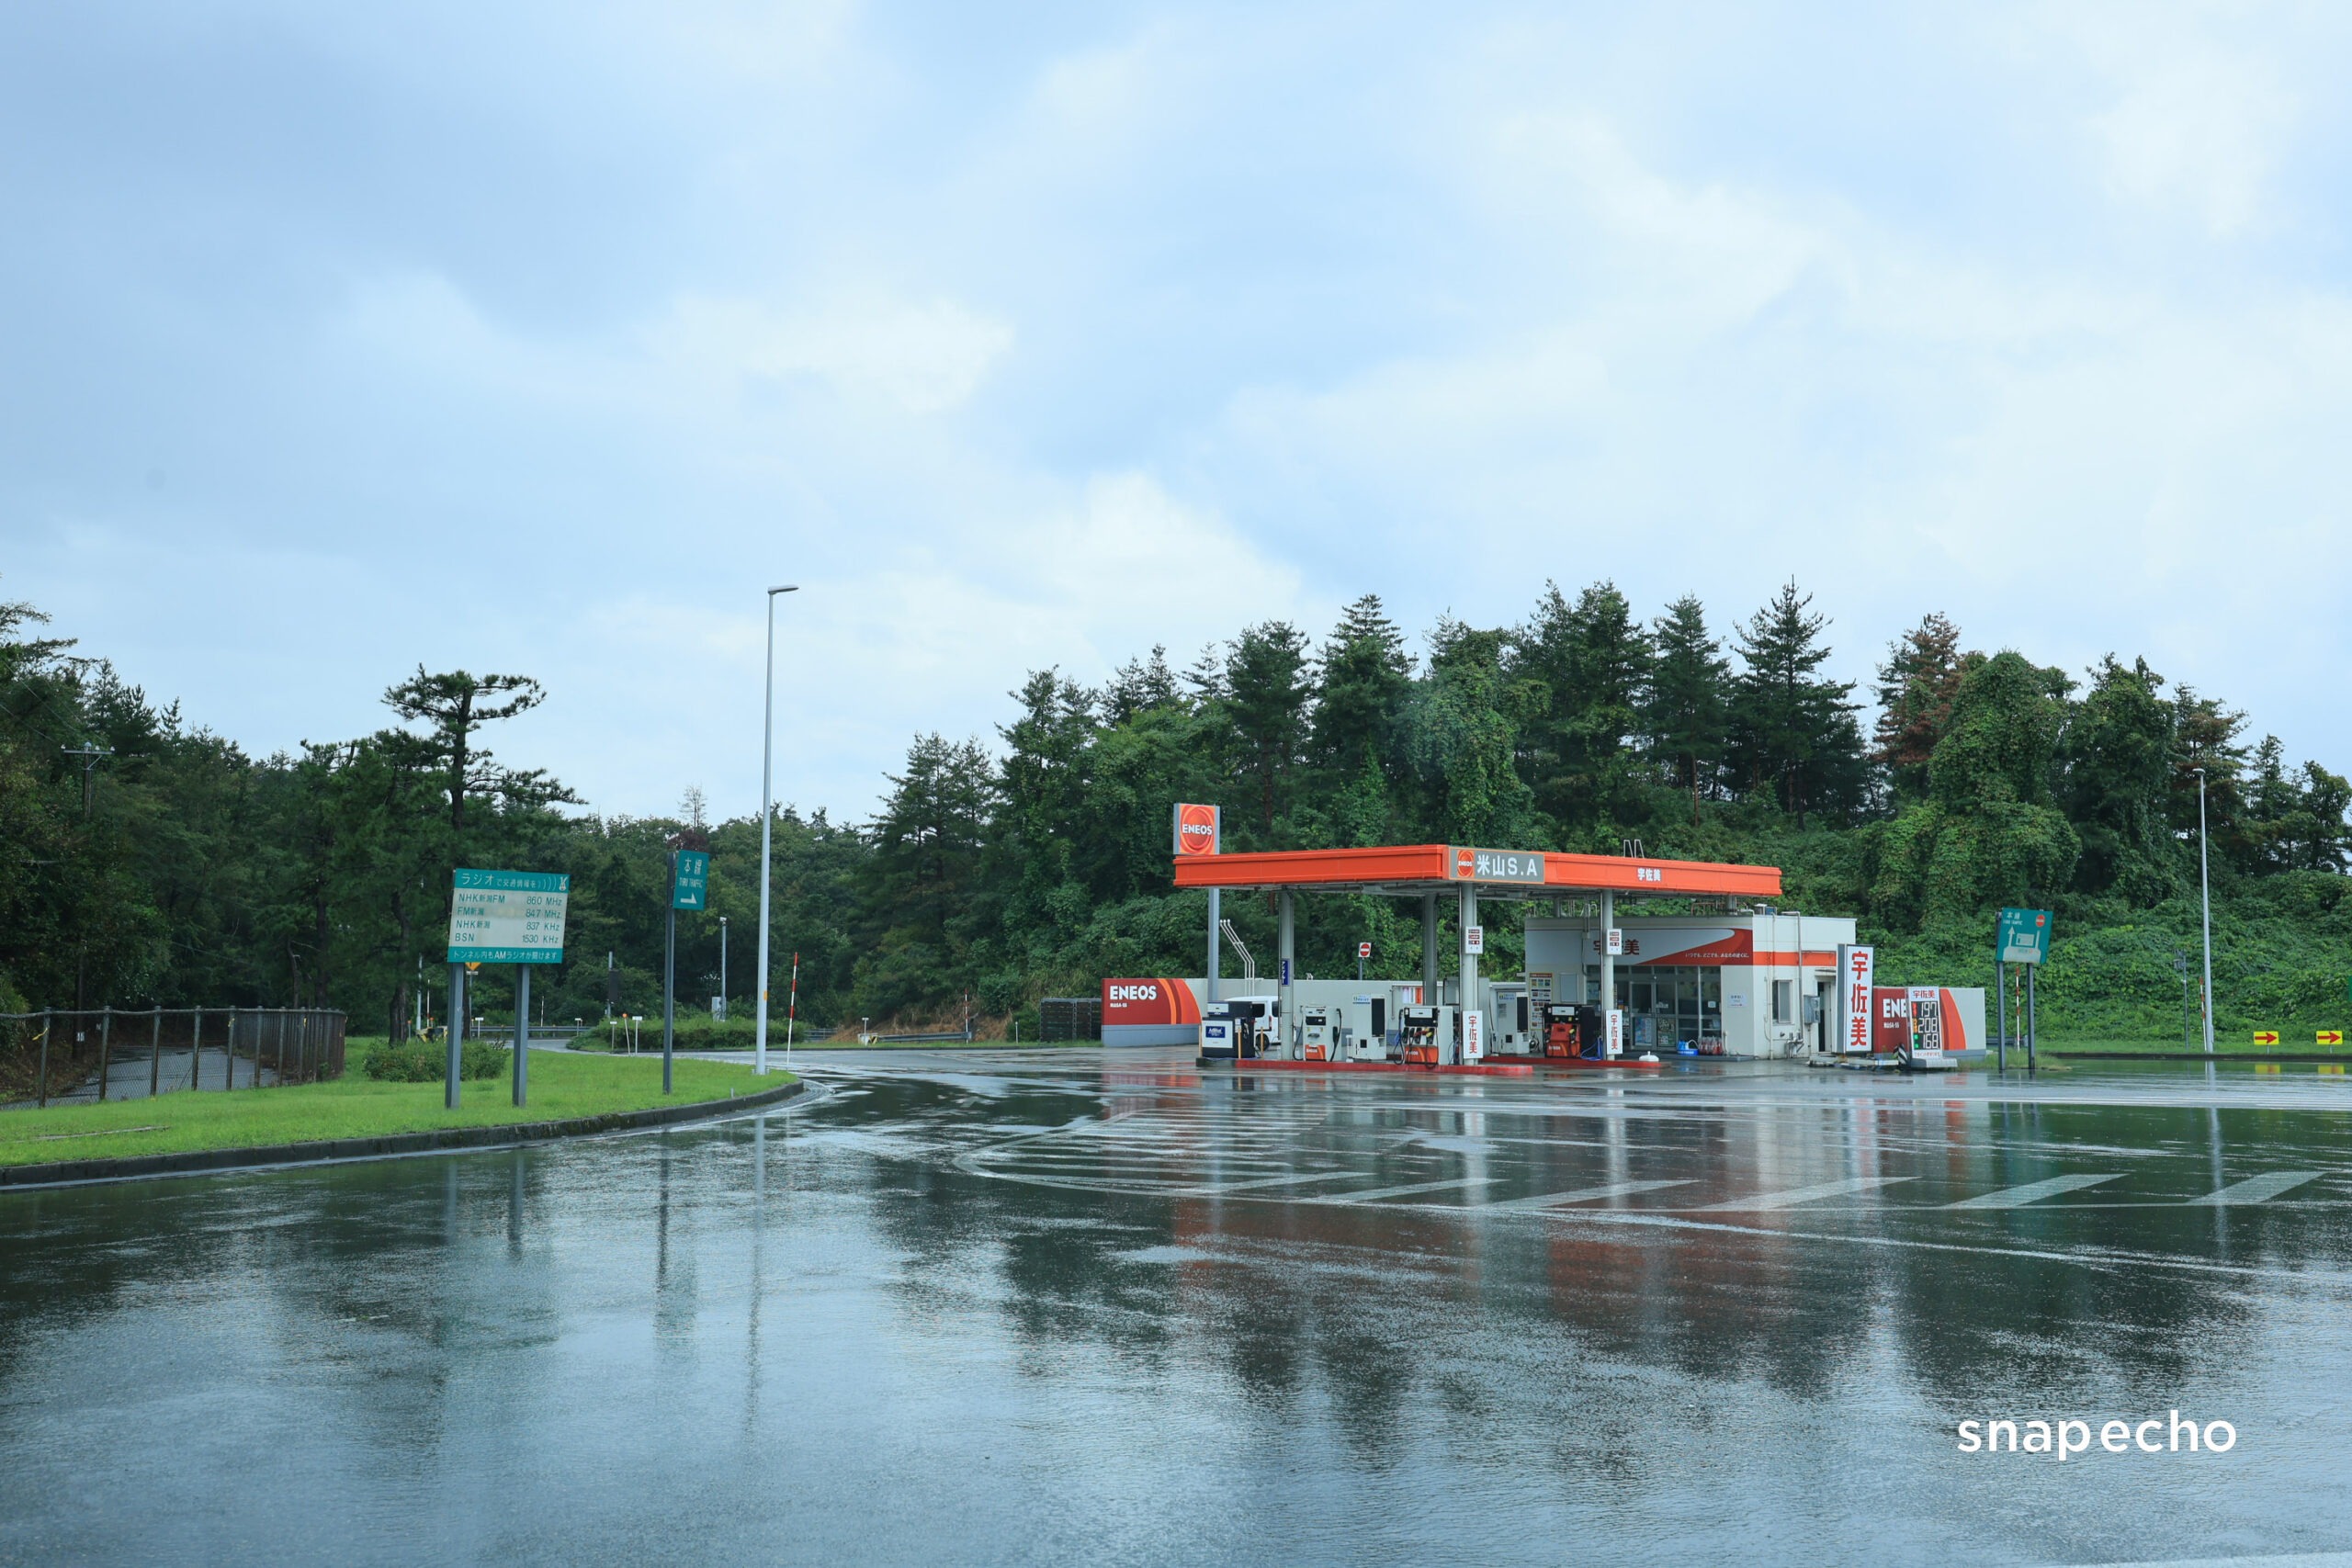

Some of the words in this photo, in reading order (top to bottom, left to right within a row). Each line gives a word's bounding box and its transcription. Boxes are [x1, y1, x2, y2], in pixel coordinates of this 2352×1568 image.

[1182, 823, 1213, 836] ENEOS
[1637, 868, 1661, 882] 宇佐美
[546, 897, 562, 907] MHz
[544, 909, 561, 919] MHz
[526, 921, 540, 931] 837
[544, 922, 560, 931] KHz
[455, 932, 475, 942] BSN
[522, 934, 539, 944] 1530
[543, 935, 560, 944] KHz
[1109, 985, 1158, 1000] ENEOS
[1850, 951, 1869, 1046] 宇佐美
[1913, 989, 1936, 998] 宇佐美
[1883, 998, 1907, 1018] ENE
[1921, 1001, 1938, 1018] 197
[1610, 1014, 1618, 1050] 宇佐美
[1917, 1018, 1939, 1033] 208
[1468, 1015, 1477, 1055] 宇佐美
[1923, 1033, 1939, 1049] 168
